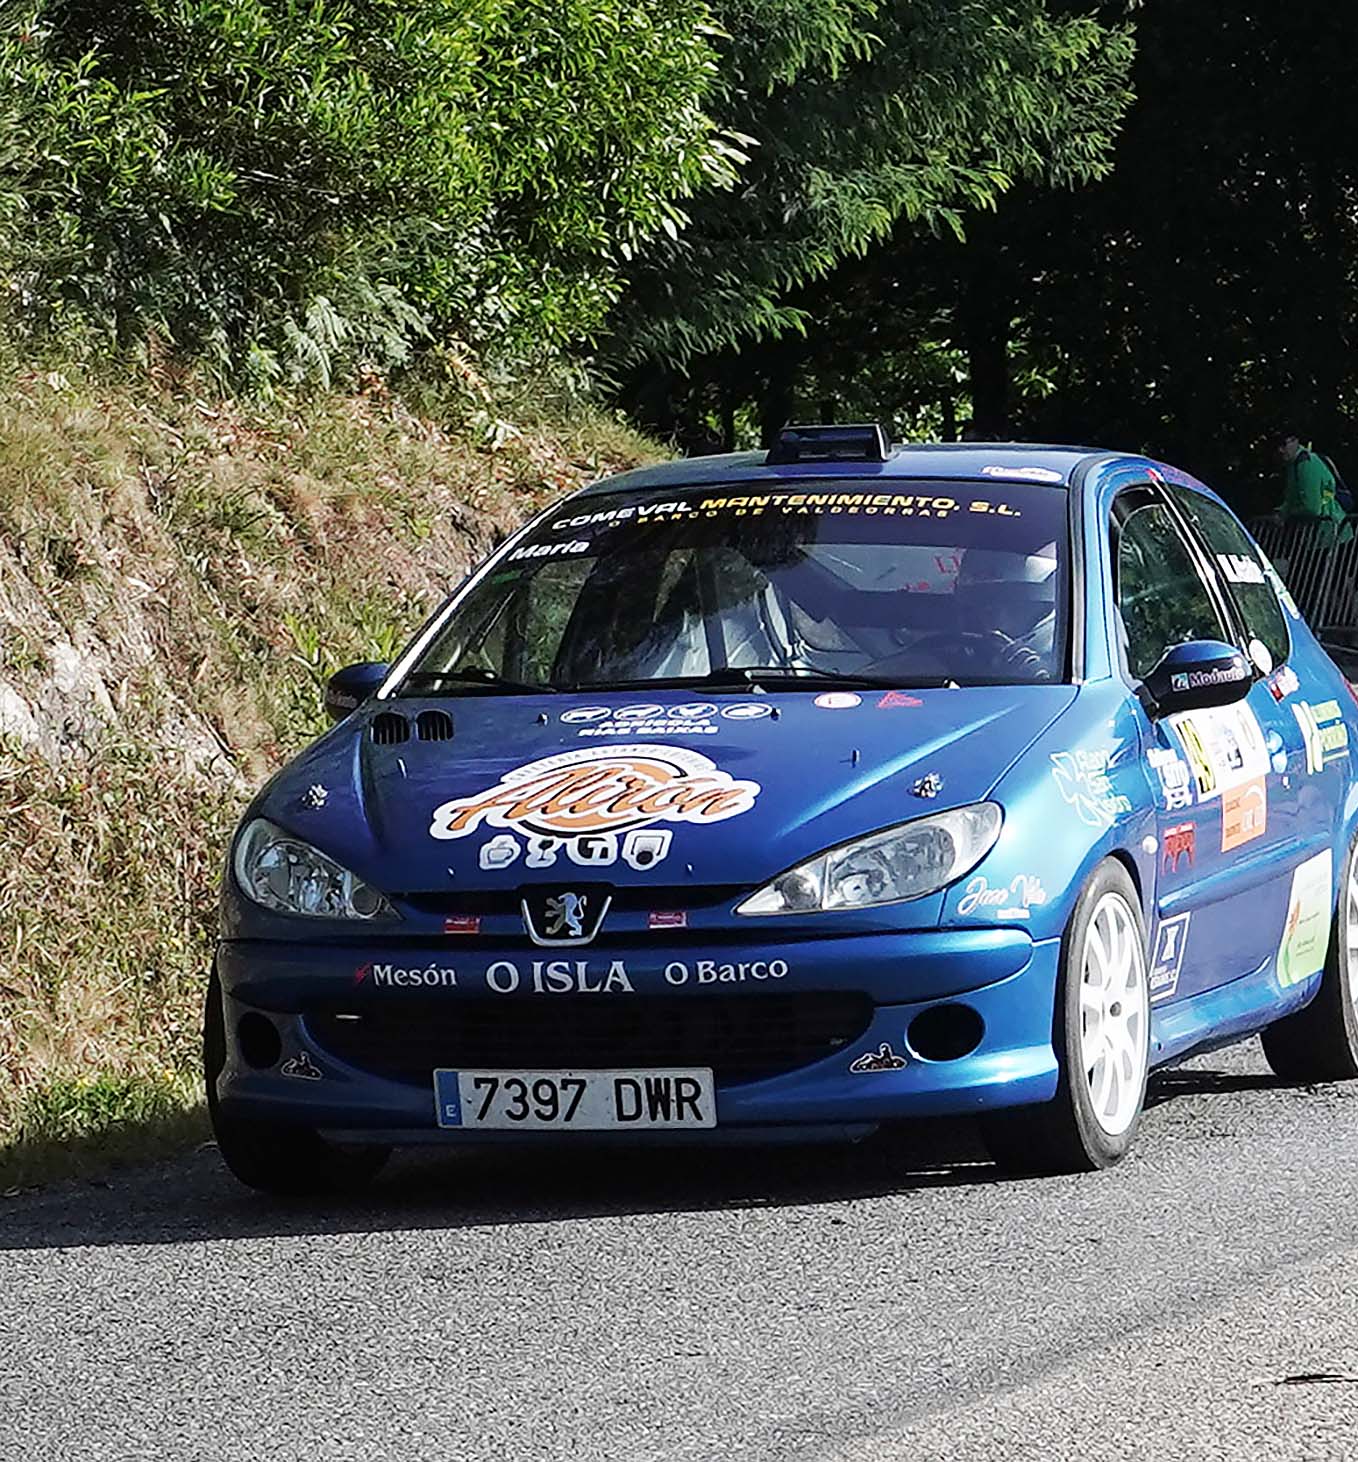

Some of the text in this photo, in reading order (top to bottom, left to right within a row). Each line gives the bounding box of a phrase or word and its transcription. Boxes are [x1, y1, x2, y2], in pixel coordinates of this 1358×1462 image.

[551, 501, 692, 530] COMEVAL
[968, 499, 1022, 517] S.L.
[608, 505, 948, 528] O BARCO DE VALDEORRAS
[372, 957, 788, 993] Mesón O ISLA O Barco
[472, 1077, 703, 1122] 7397 DWR
